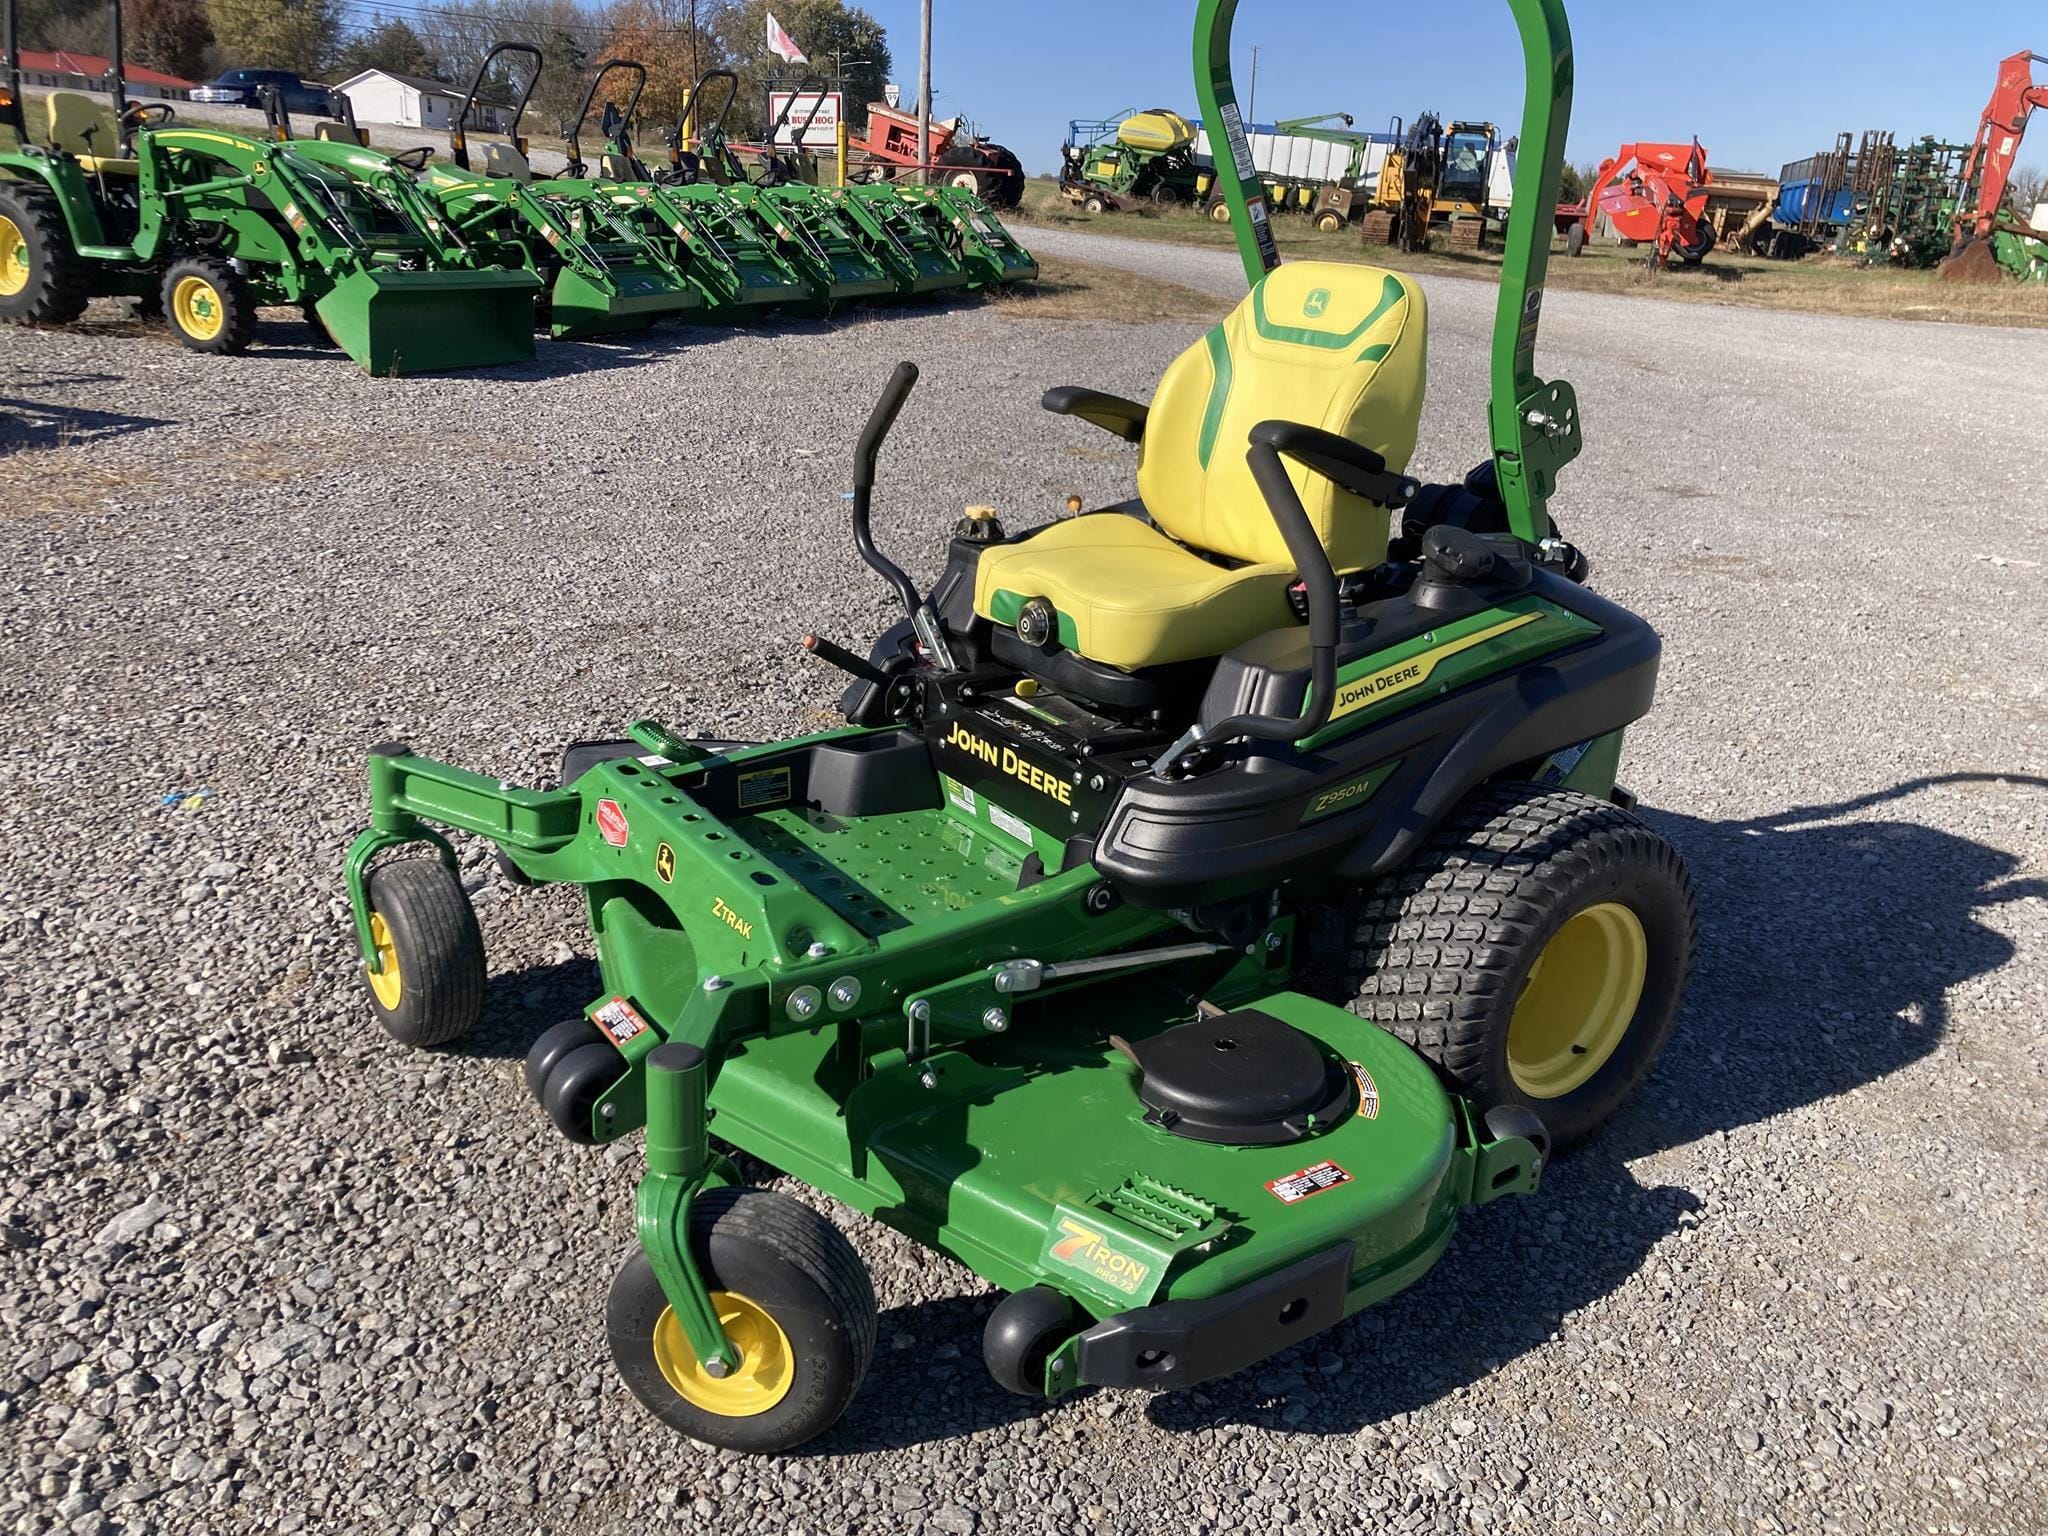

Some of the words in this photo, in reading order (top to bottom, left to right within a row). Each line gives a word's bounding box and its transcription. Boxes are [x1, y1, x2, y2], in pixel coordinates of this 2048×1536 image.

[791, 116, 813, 124] BUS
[815, 116, 834, 124] HOG
[1338, 682, 1375, 708] JOHN
[1377, 664, 1421, 691] DEERE
[947, 721, 998, 767] JOHN
[1002, 746, 1072, 806] DEERE
[1314, 780, 1370, 813] Z950M
[711, 896, 753, 940] ZTRAK
[1095, 1267, 1118, 1283] PRO
[1119, 1278, 1134, 1291] 72
